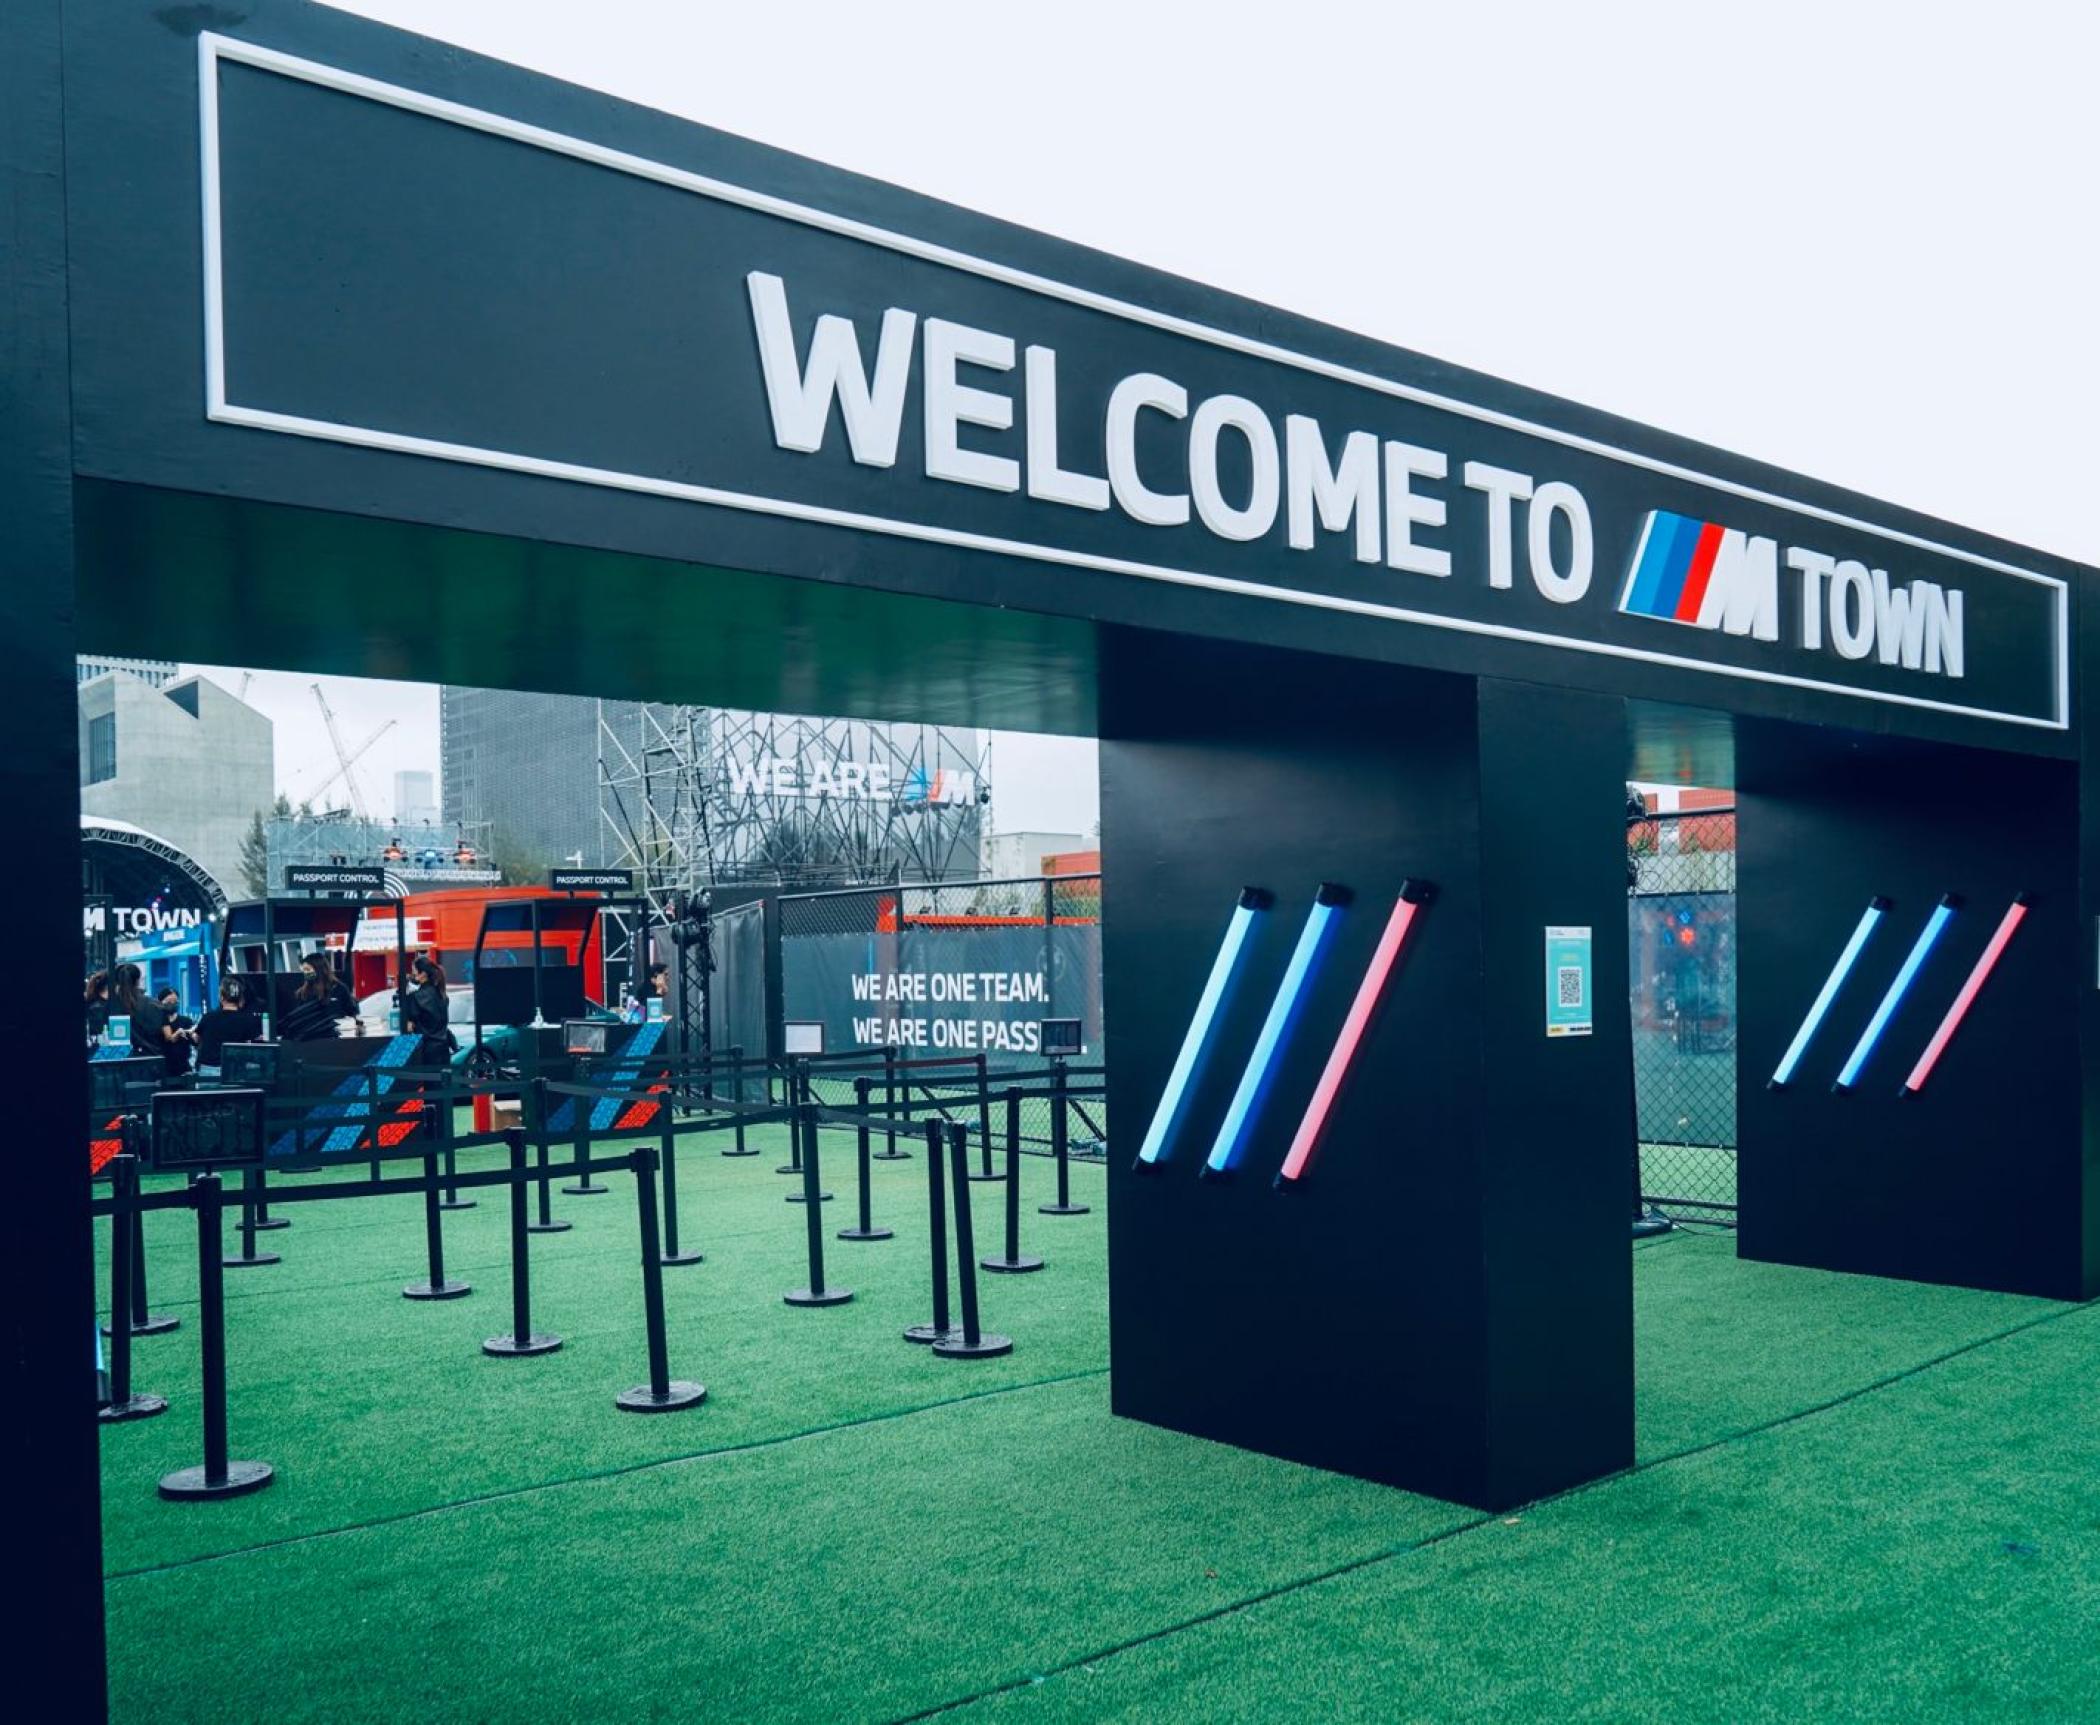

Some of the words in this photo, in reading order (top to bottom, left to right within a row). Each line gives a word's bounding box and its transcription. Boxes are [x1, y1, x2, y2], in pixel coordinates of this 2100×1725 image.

[746, 270, 1453, 578] WELCOME
[1464, 460, 1594, 604] TO
[1786, 546, 1965, 678] TOWN
[727, 755, 801, 796] WE
[808, 760, 892, 799] ARE
[293, 873, 338, 883] PASSPORT
[339, 873, 379, 884] CONTROL
[556, 876, 594, 884] PASSPORT
[595, 876, 628, 885] CONTROL
[112, 907, 201, 932] TOWN
[852, 973, 882, 1001] WE
[884, 973, 927, 1001] ARE
[931, 972, 977, 1002] ONE
[979, 972, 1049, 1002] TEAM.
[853, 1017, 883, 1045] WE
[886, 1018, 928, 1047] ARE
[932, 1018, 978, 1049] ONE
